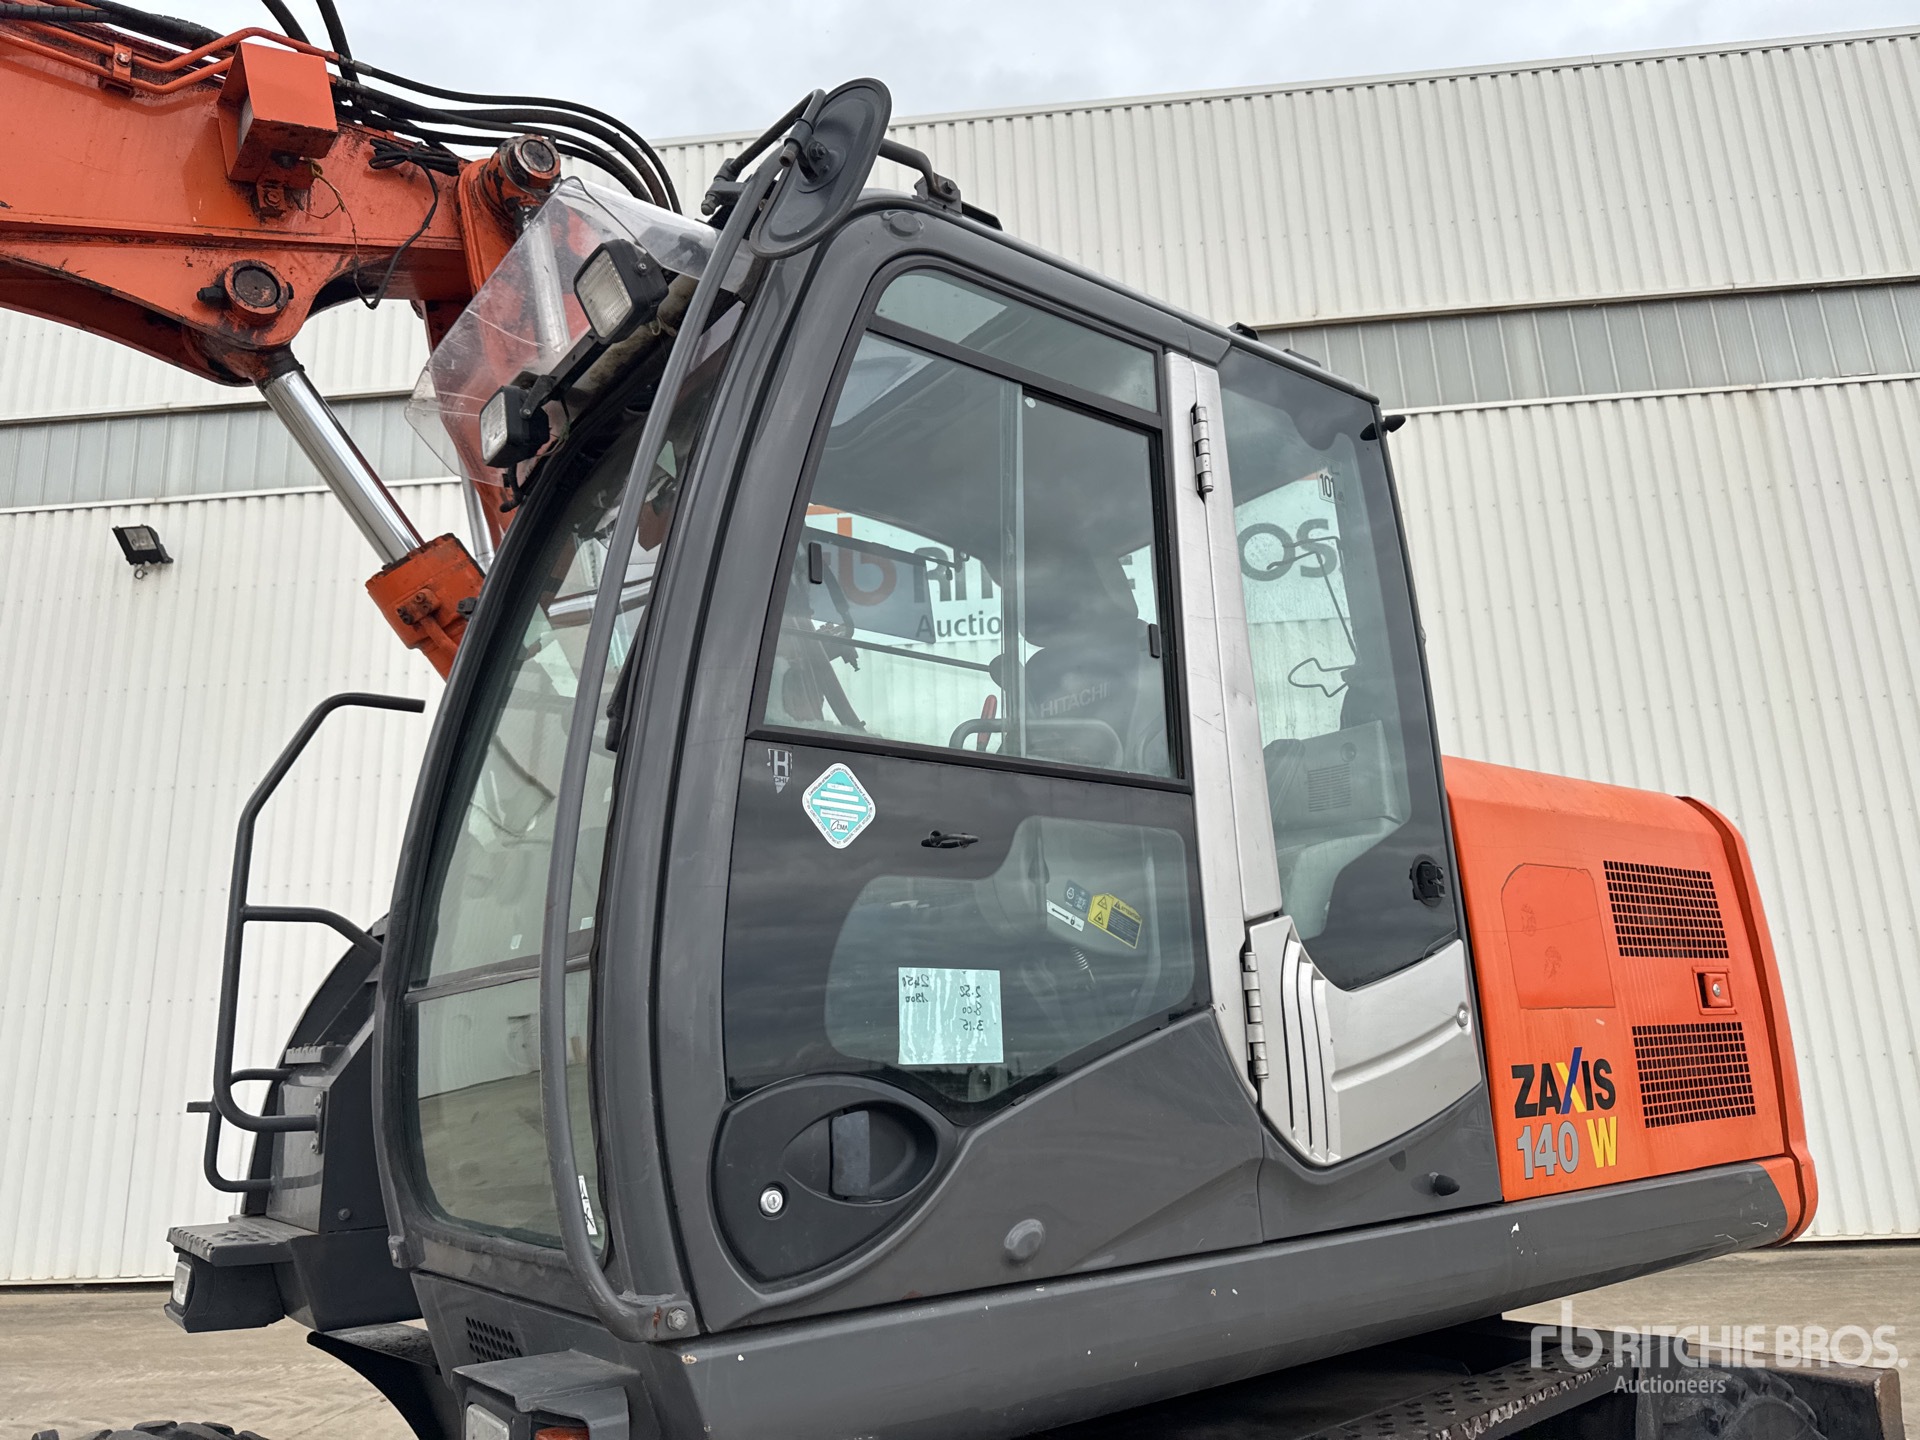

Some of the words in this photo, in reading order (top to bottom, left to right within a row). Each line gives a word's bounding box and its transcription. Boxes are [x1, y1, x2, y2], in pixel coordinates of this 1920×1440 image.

[1040, 681, 1109, 719] HITACHI
[1511, 1046, 1617, 1119] ZAXIS
[1516, 1120, 1579, 1180] 140
[1586, 1115, 1617, 1168] W
